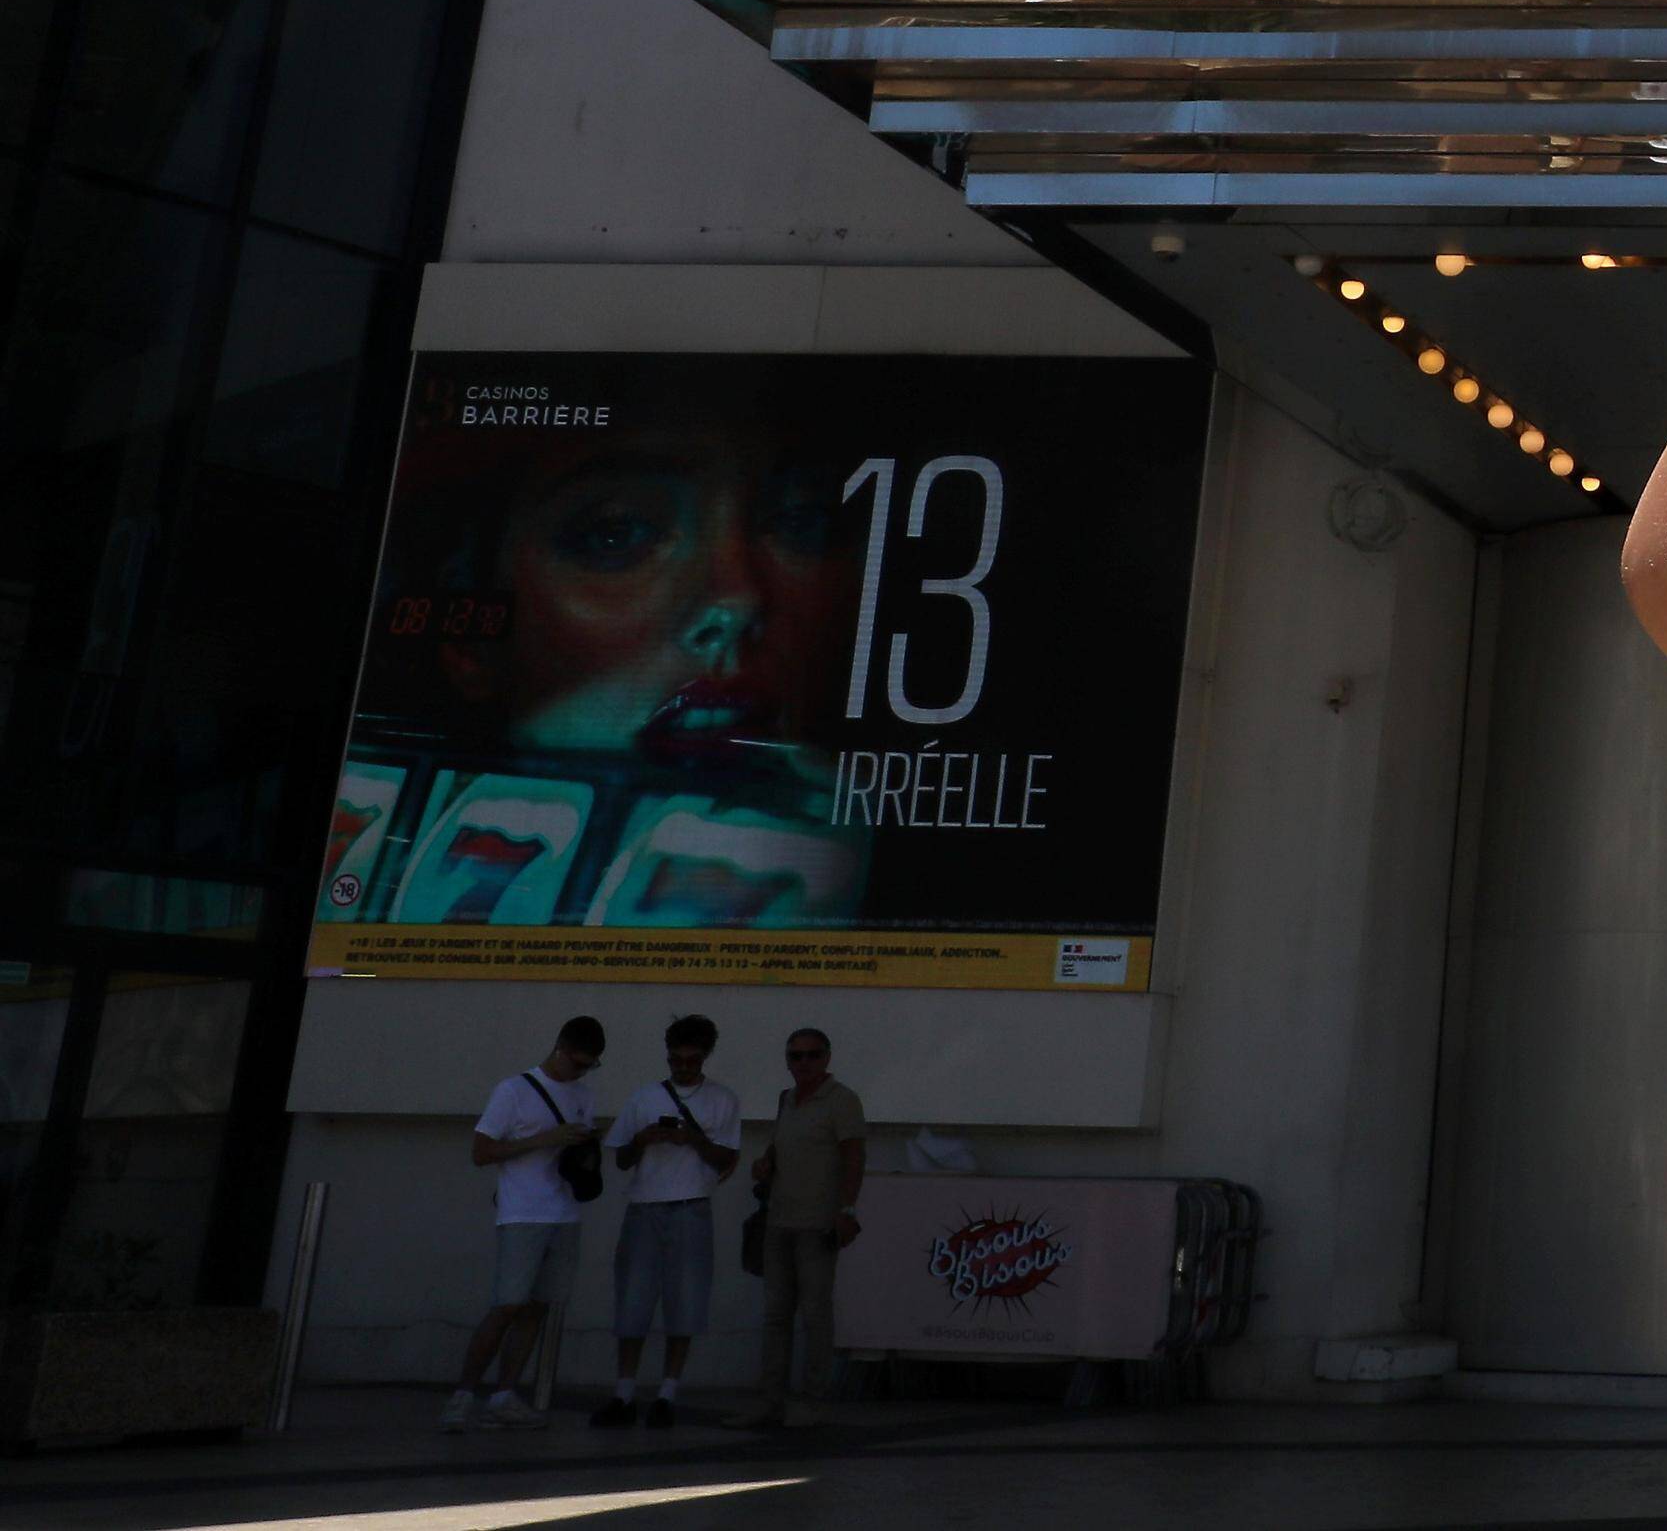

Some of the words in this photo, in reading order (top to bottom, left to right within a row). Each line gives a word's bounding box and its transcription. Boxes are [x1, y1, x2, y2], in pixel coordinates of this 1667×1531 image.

[465, 386, 550, 400] CASINOS
[461, 404, 611, 426] BARRIÈRE
[841, 453, 1004, 725] 13
[831, 740, 1054, 830] IRRÉELLE
[345, 952, 411, 963] RETROUVEZ
[413, 953, 435, 964] NOS
[438, 953, 491, 964] CONSEILS
[494, 954, 515, 965] SUR
[759, 959, 795, 970] APPEL
[798, 959, 822, 971] NON
[376, 938, 397, 948] LES
[399, 939, 427, 949] JEUX
[429, 939, 483, 949] D'ARGENT
[485, 940, 499, 949] ET
[501, 940, 515, 949] DE
[516, 940, 563, 950] HASARD
[564, 940, 615, 951] PEUVENT
[616, 939, 643, 952] ÊTRE
[646, 941, 711, 953] DANGEREUX
[719, 943, 761, 954] PERTES
[821, 945, 875, 956] CONFLITS
[877, 946, 937, 958] FAMILIAUX,
[929, 1218, 1052, 1277] Bisous
[951, 1241, 1073, 1302] Bisous
